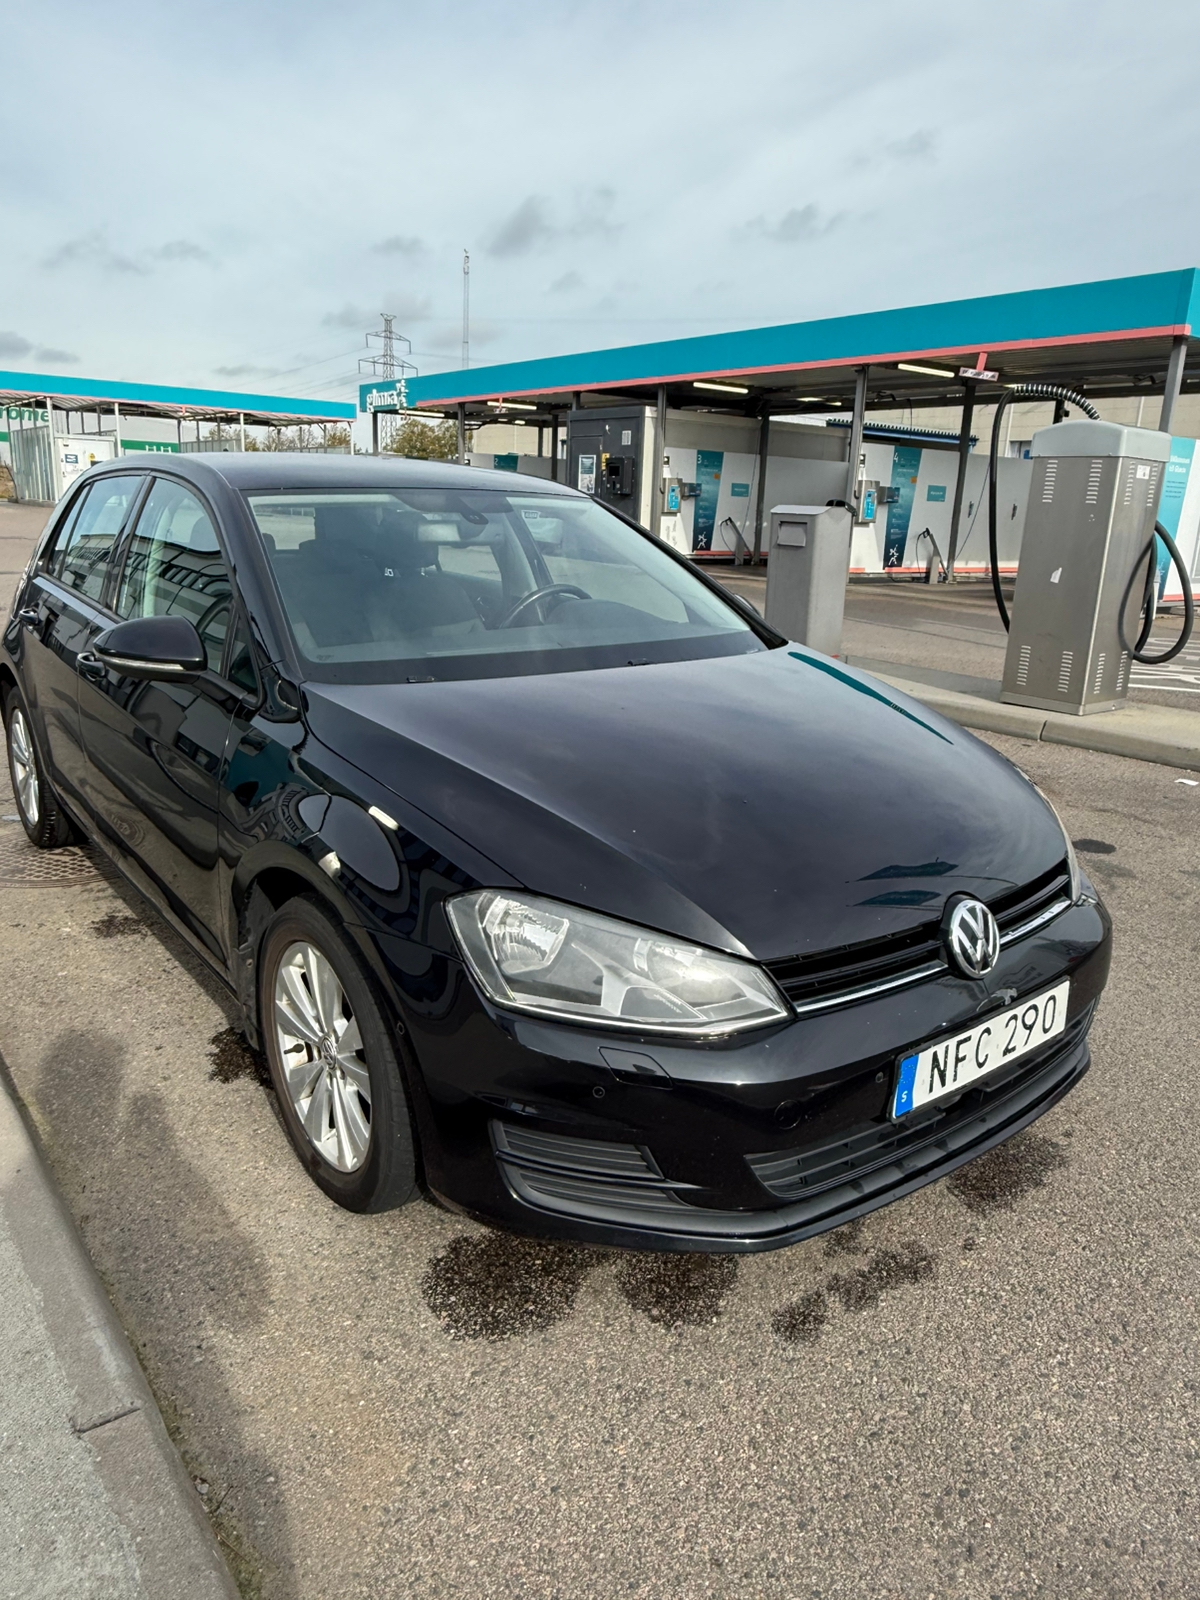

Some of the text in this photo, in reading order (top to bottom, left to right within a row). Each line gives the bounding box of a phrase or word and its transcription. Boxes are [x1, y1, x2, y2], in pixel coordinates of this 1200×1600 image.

[697, 454, 702, 464] 3
[928, 994, 1057, 1095] NFC 290
[900, 1090, 909, 1103] S
